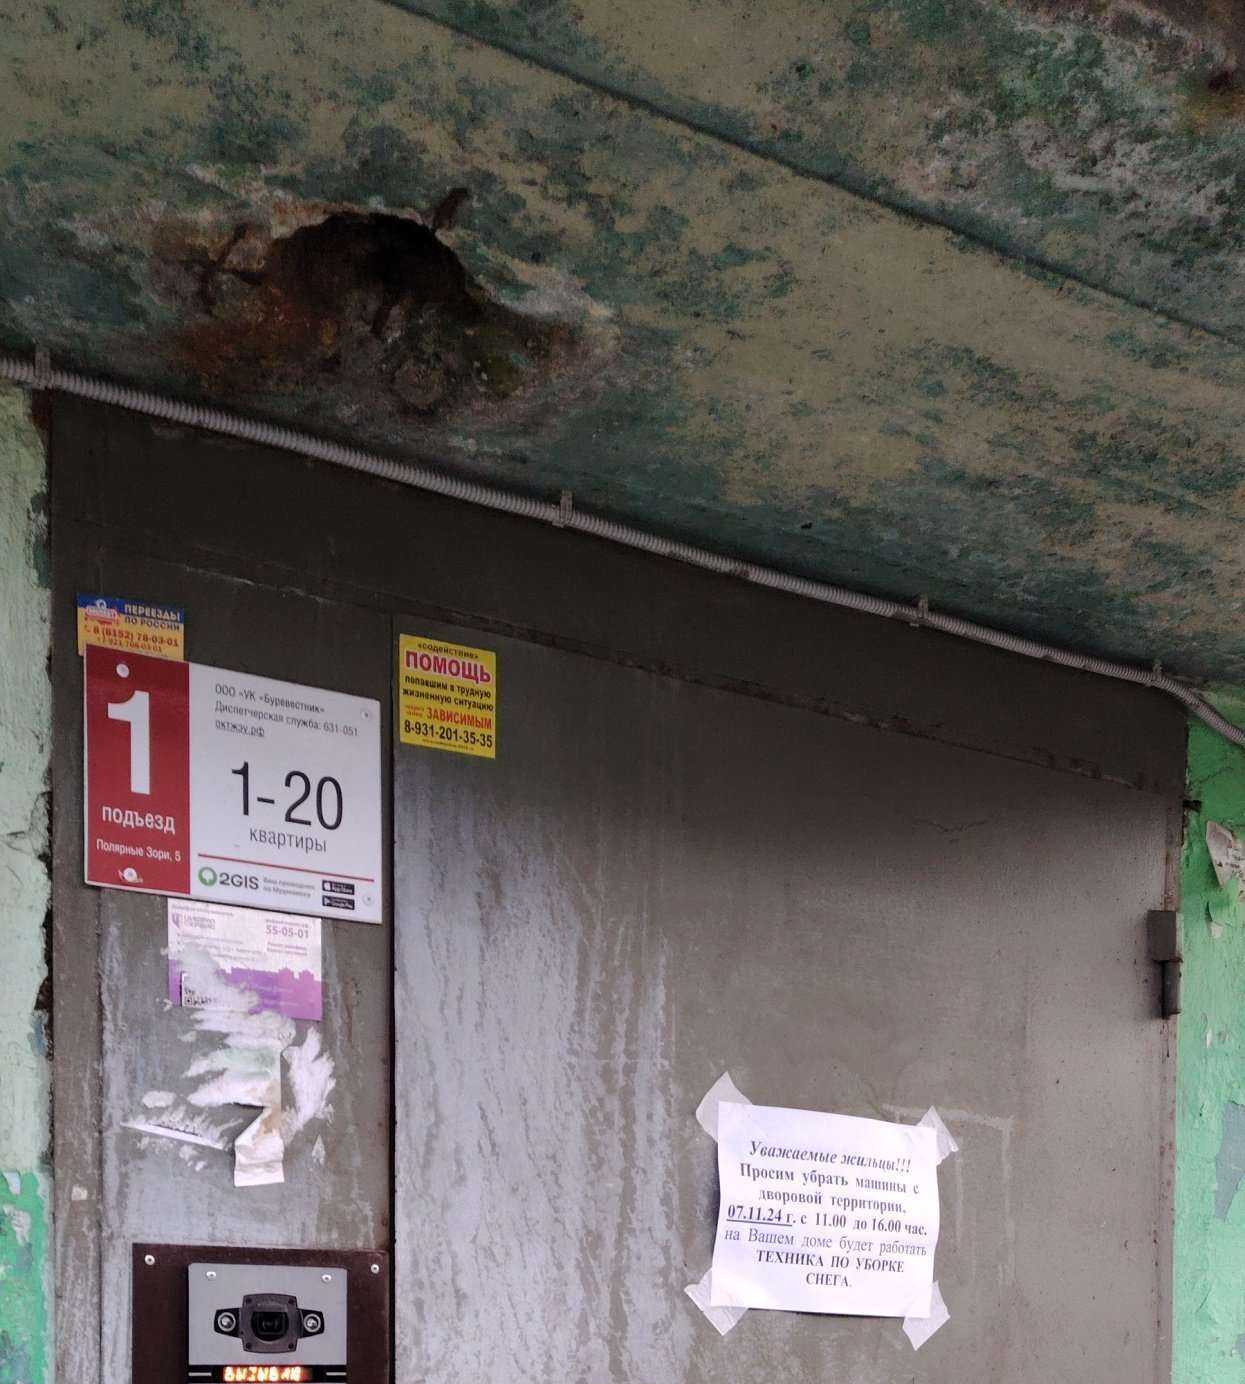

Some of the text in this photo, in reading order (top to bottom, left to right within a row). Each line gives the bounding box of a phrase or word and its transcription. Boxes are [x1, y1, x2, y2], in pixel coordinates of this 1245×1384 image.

[124, 604, 181, 622] ПЕРЕЕЗДЫ
[125, 616, 180, 631] ПО РОССИИ
[406, 650, 491, 684] ПОМОЩЬ
[215, 683, 236, 697] ООО
[402, 688, 494, 711] жизненную ситуацию
[405, 675, 448, 690] попавшим
[457, 686, 491, 700] трудную
[215, 700, 358, 737] Диспетчерская служба: 631-051
[427, 706, 492, 730] ЗАВИСИМЫМ
[107, 690, 151, 795] 1
[404, 719, 493, 748] 8-931-201-35-35
[231, 761, 344, 831] 1-20
[102, 806, 176, 835] подъезд
[96, 838, 182, 862] Полярные Зори, 5
[250, 828, 328, 853] квартиры
[219, 872, 260, 891] 2GIS
[265, 925, 309, 939] 55-05-01
[750, 1140, 911, 1173] Уважаемые жильцы!!!
[740, 1163, 920, 1194] Просим убрать машины с
[758, 1189, 907, 1214] дворовой территории.
[727, 1204, 928, 1236] 07.11.24 г. с 11.00 до 16.00 час.
[724, 1228, 928, 1257] на Вашем доме будет работать
[756, 1250, 905, 1273] ТЕХНИКА ПО УБОРКЕ
[806, 1272, 852, 1288] СНЕГА.
